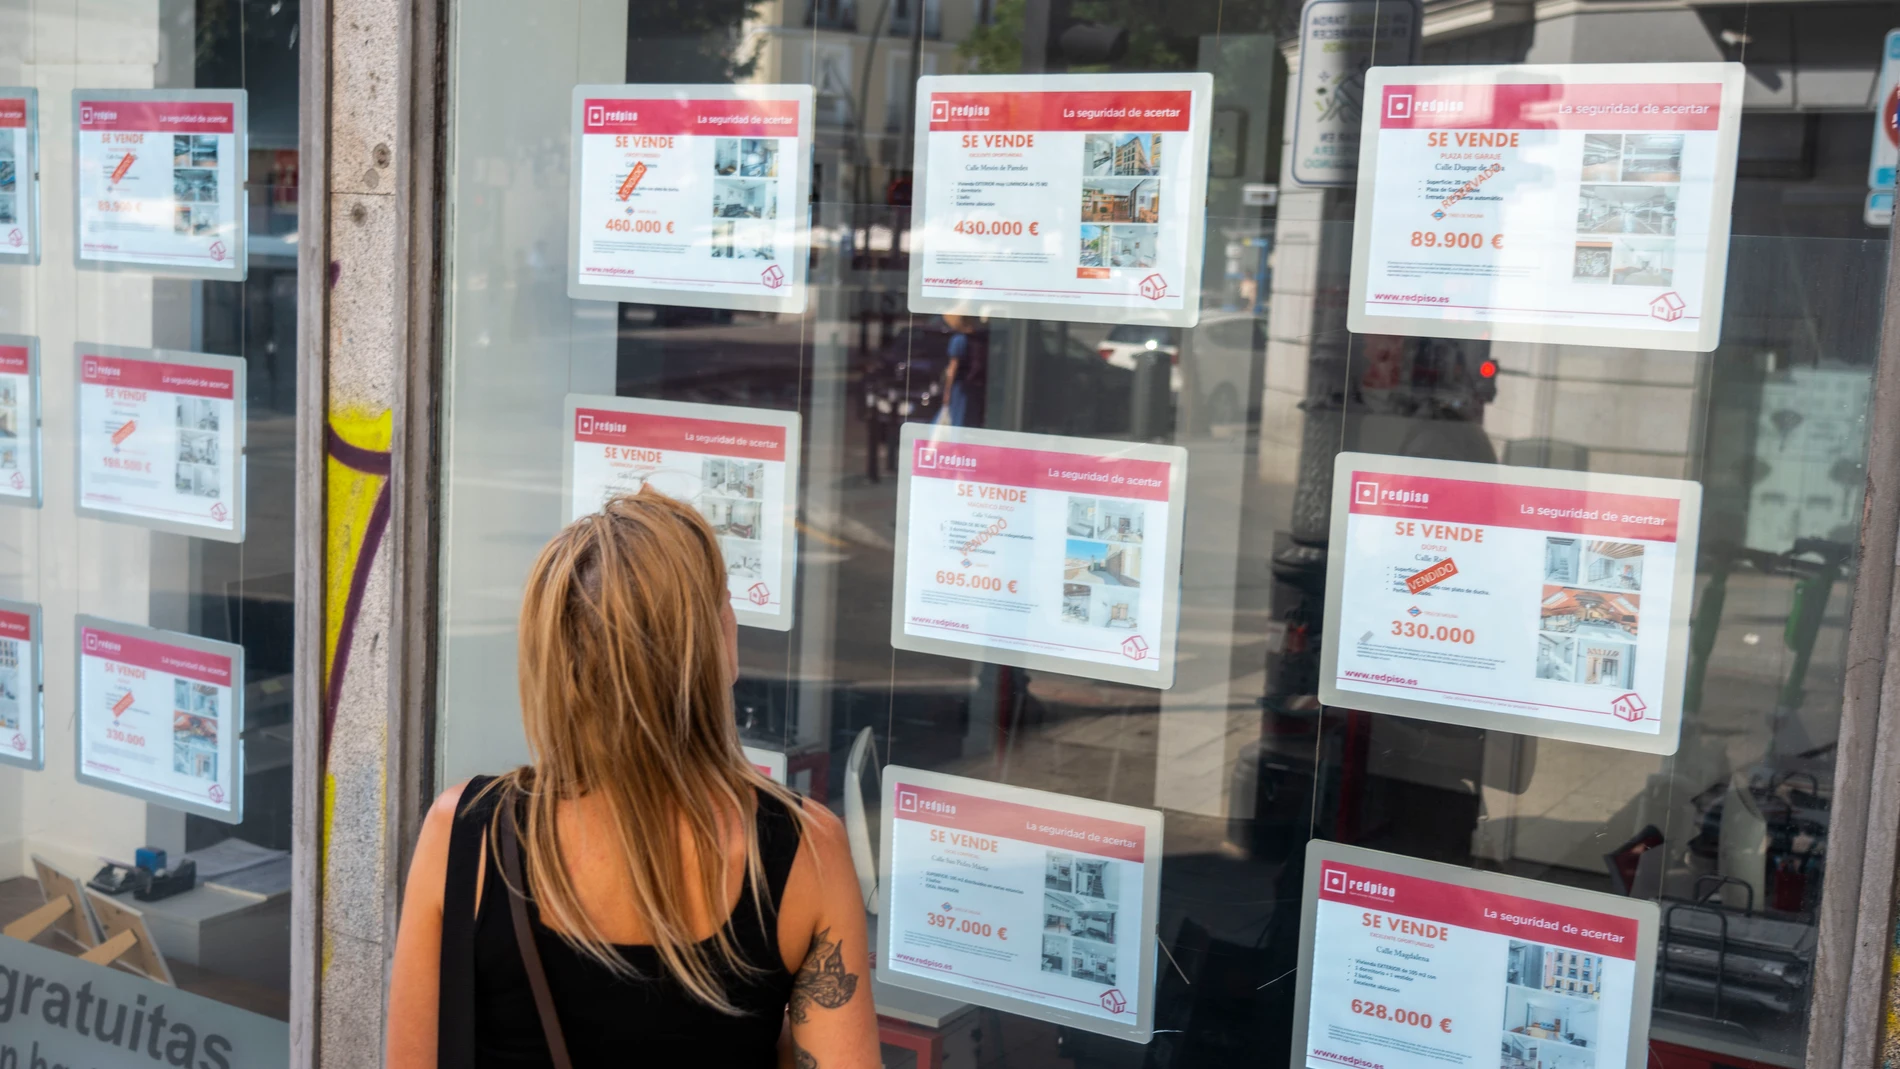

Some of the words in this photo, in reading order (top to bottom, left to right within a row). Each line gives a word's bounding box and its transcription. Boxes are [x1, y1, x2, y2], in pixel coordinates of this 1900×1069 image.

[951, 105, 990, 117] redpiso
[1064, 108, 1074, 118] La
[1077, 108, 1125, 119] seguridad
[1128, 108, 1142, 117] de
[1144, 109, 1180, 118] acertar
[1414, 99, 1464, 113] redpiso
[1558, 104, 1572, 114] La
[1576, 103, 1638, 116] seguridad
[1642, 104, 1659, 114] de
[1662, 104, 1709, 114] acertar
[606, 111, 638, 122] redpiso
[698, 115, 707, 124] La
[708, 115, 749, 126] seguridad
[751, 116, 761, 124] de
[763, 116, 793, 124] acertar
[102, 134, 110, 143] SE
[115, 134, 144, 144] VENDE
[616, 136, 628, 147] SE
[633, 136, 674, 148] VENDE
[962, 134, 978, 148] SE
[984, 134, 1034, 148] VENDE
[1428, 132, 1448, 147] SE
[1455, 132, 1519, 147] VENDE
[1435, 163, 1452, 171] Calle
[1454, 164, 1476, 172] Duque
[1442, 163, 1501, 208] RESERVADO
[606, 219, 661, 233] 460.000
[666, 221, 674, 234] €
[954, 220, 1023, 236] 430.000
[1028, 222, 1039, 236] €
[1411, 231, 1483, 248] 89.900
[1491, 234, 1504, 249] €
[924, 276, 983, 286] www.redpiso.es
[1374, 292, 1449, 304] www.redpiso.es
[105, 388, 115, 398] SE
[117, 390, 147, 402] VENDE
[595, 422, 627, 433] redpiso
[685, 432, 694, 440] La
[696, 434, 735, 444] seguridad
[737, 437, 747, 446] de
[749, 440, 778, 448] acertar
[604, 446, 617, 458] SE
[621, 448, 662, 463] VENDE
[939, 455, 976, 467] redpiso
[1048, 468, 1060, 477] La
[1062, 470, 1108, 482] seguridad
[1111, 474, 1124, 483] de
[1126, 477, 1162, 487] acertar
[958, 484, 974, 497] SE
[978, 485, 1027, 503] VENDE
[1381, 489, 1429, 503] redpiso
[1520, 504, 1534, 514] La
[1537, 505, 1598, 520] seguridad
[1602, 511, 1618, 522] de
[1622, 514, 1666, 526] acertar
[1395, 521, 1415, 536] SE
[1421, 523, 1484, 543] VENDE
[1415, 554, 1431, 562] Calle
[936, 570, 1001, 591] 695.000
[1008, 580, 1018, 593] €
[1408, 563, 1454, 590] VENDIDO
[911, 616, 970, 630] www.redpiso.es
[1391, 620, 1475, 644] 330.000
[117, 665, 146, 680] VENDE
[1344, 669, 1418, 686] www.redpiso.es
[920, 800, 956, 815] redpiso
[930, 829, 945, 843] SE
[950, 833, 998, 853] VENDE
[1026, 821, 1037, 831] La
[1039, 823, 1085, 840] seguridad
[1088, 833, 1100, 842] de
[1102, 836, 1136, 848] acertar
[931, 854, 945, 862] Calle
[1349, 880, 1395, 897] redpiso
[927, 912, 992, 937] 397.000
[997, 927, 1007, 940] €
[1362, 912, 1382, 928] SE
[1388, 917, 1448, 941] VENDE
[1484, 908, 1497, 918] La
[1500, 912, 1559, 931] seguridad
[1562, 924, 1578, 934] de
[1581, 928, 1624, 943] acertar
[896, 952, 953, 970] www.redpiso.es
[1376, 946, 1392, 955] Calle
[1394, 949, 1430, 962] Magdalena
[0, 964, 233, 1069] gratuitas
[1351, 999, 1432, 1028] 628.000
[1439, 1018, 1452, 1033] €
[1313, 1048, 1384, 1069] www.redpiso.es
